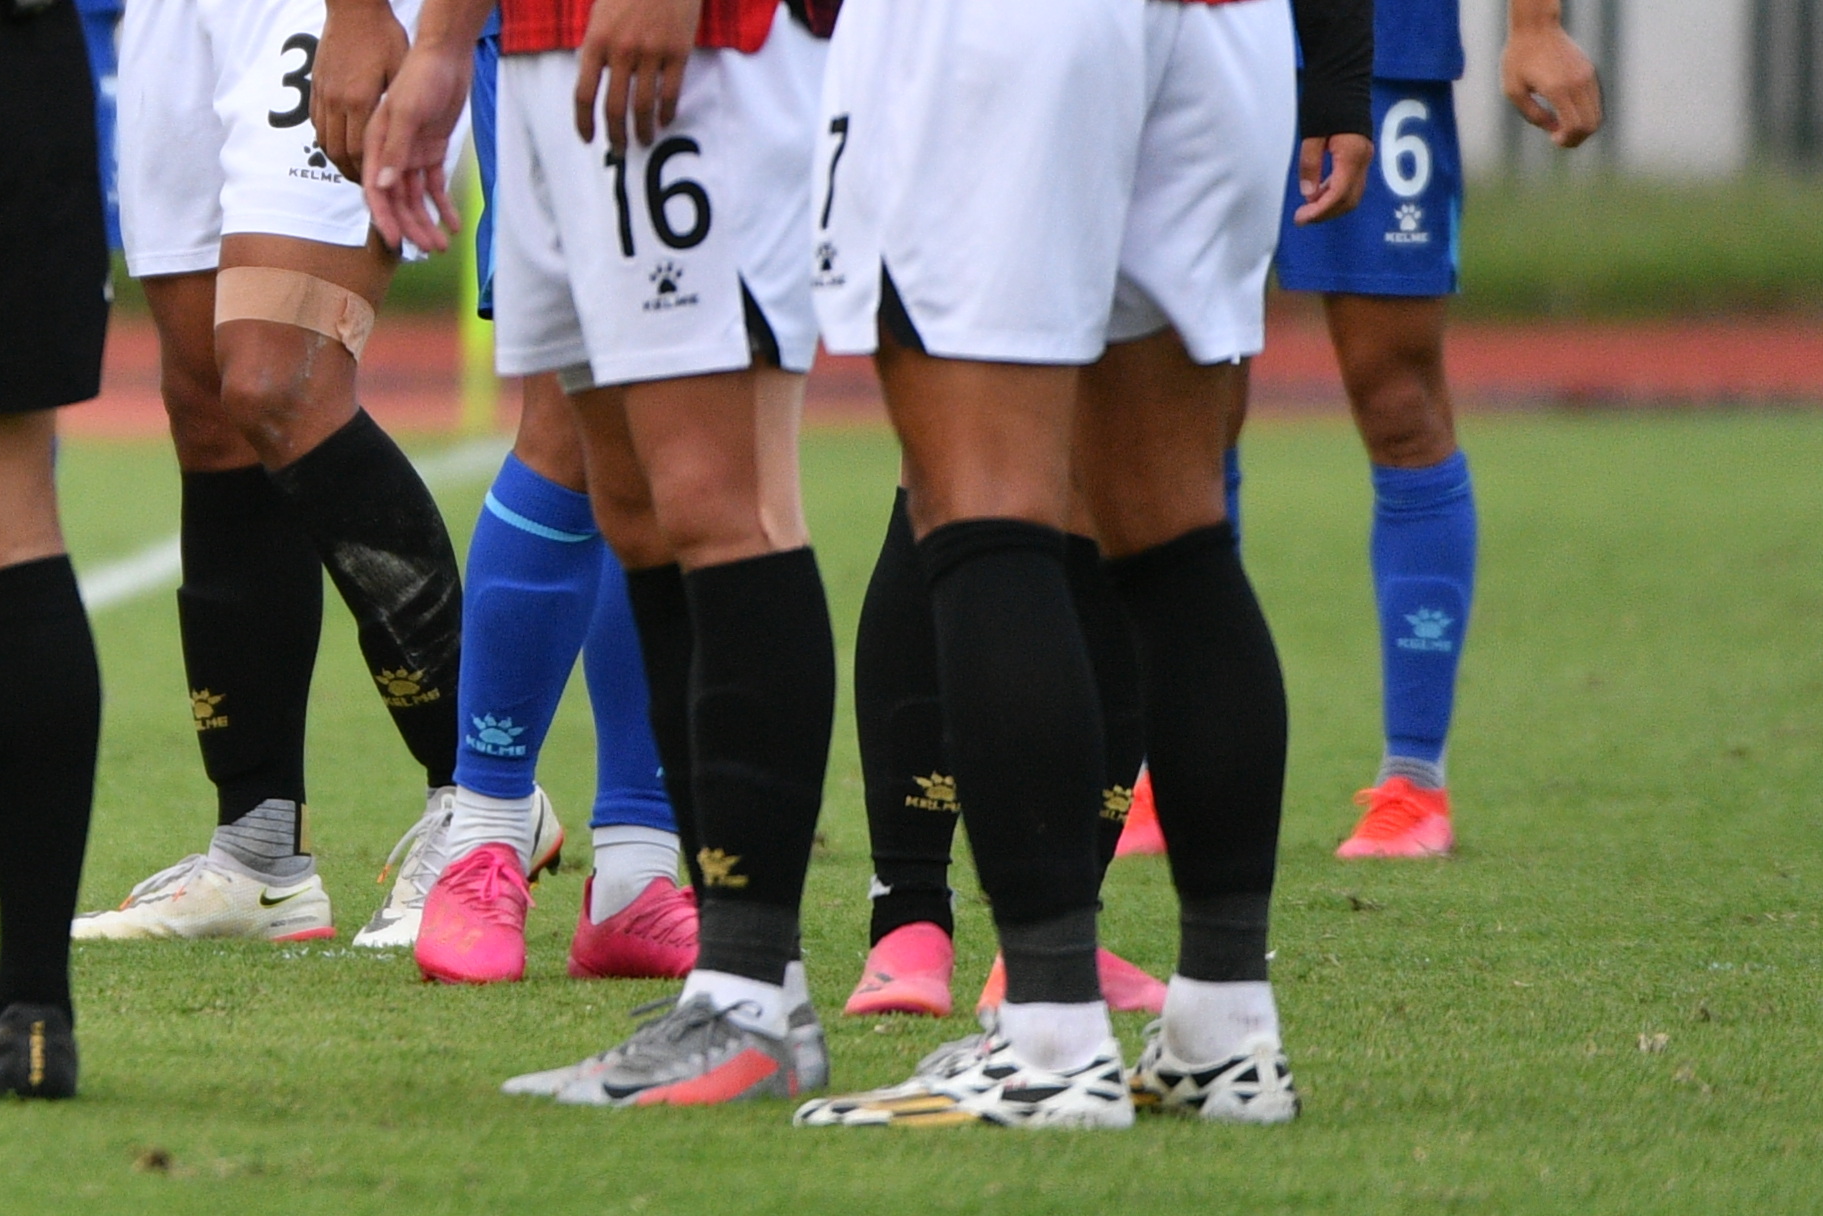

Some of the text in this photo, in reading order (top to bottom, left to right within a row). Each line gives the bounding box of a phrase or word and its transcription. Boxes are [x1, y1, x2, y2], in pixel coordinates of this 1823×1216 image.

[288, 167, 343, 184] KELME
[605, 135, 712, 258] 16
[819, 114, 849, 230] 7
[1380, 98, 1431, 197] 6
[465, 734, 527, 756] KELME
